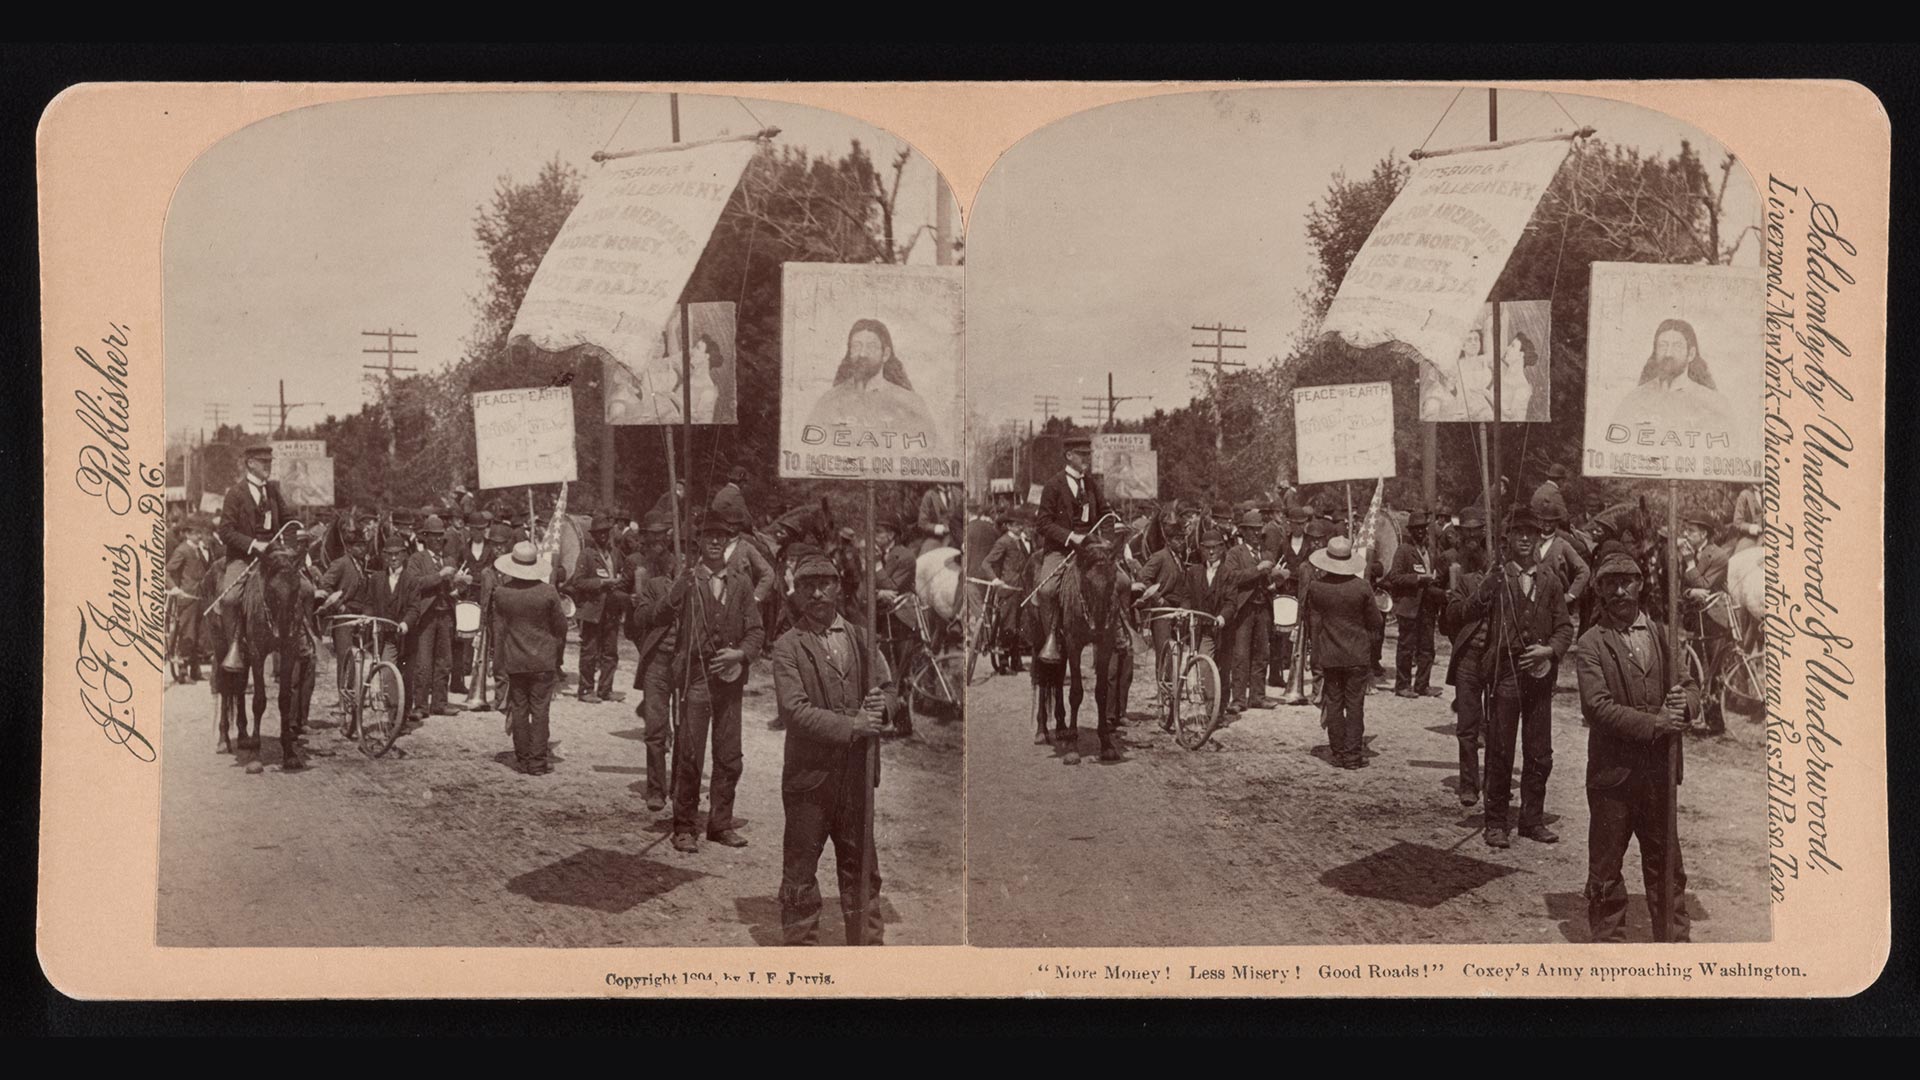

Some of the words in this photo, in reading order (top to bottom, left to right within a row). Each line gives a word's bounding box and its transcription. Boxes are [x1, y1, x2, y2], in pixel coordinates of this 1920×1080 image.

[1804, 186, 1857, 294] Sold
[1796, 283, 1852, 363] only
[476, 392, 517, 409] PEACE
[529, 388, 569, 401] EARTH
[1296, 388, 1337, 404] PEACE
[1349, 385, 1388, 399] EARTH
[1793, 352, 1854, 411] by
[74, 321, 132, 516] Publisher,
[801, 424, 927, 449] DEATH
[1605, 423, 1730, 449] DEATH
[782, 450, 800, 471] TO
[872, 456, 894, 474] ON
[1586, 449, 1605, 470] TO
[1674, 456, 1697, 473] ON
[1803, 413, 1854, 617] Underwood
[86, 534, 163, 674] Jarvis,
[1790, 604, 1854, 654] &
[76, 605, 133, 704] F.
[80, 687, 157, 763] J.
[1805, 653, 1855, 875] Underwood,
[605, 972, 677, 990] Copyright
[746, 971, 760, 985] J.
[766, 972, 781, 985] F.
[1189, 965, 1226, 980] Less
[1318, 964, 1361, 980] Good
[1537, 962, 1584, 981] Army
[1590, 962, 1693, 982] approaching
[1698, 962, 1808, 981] Washington.
